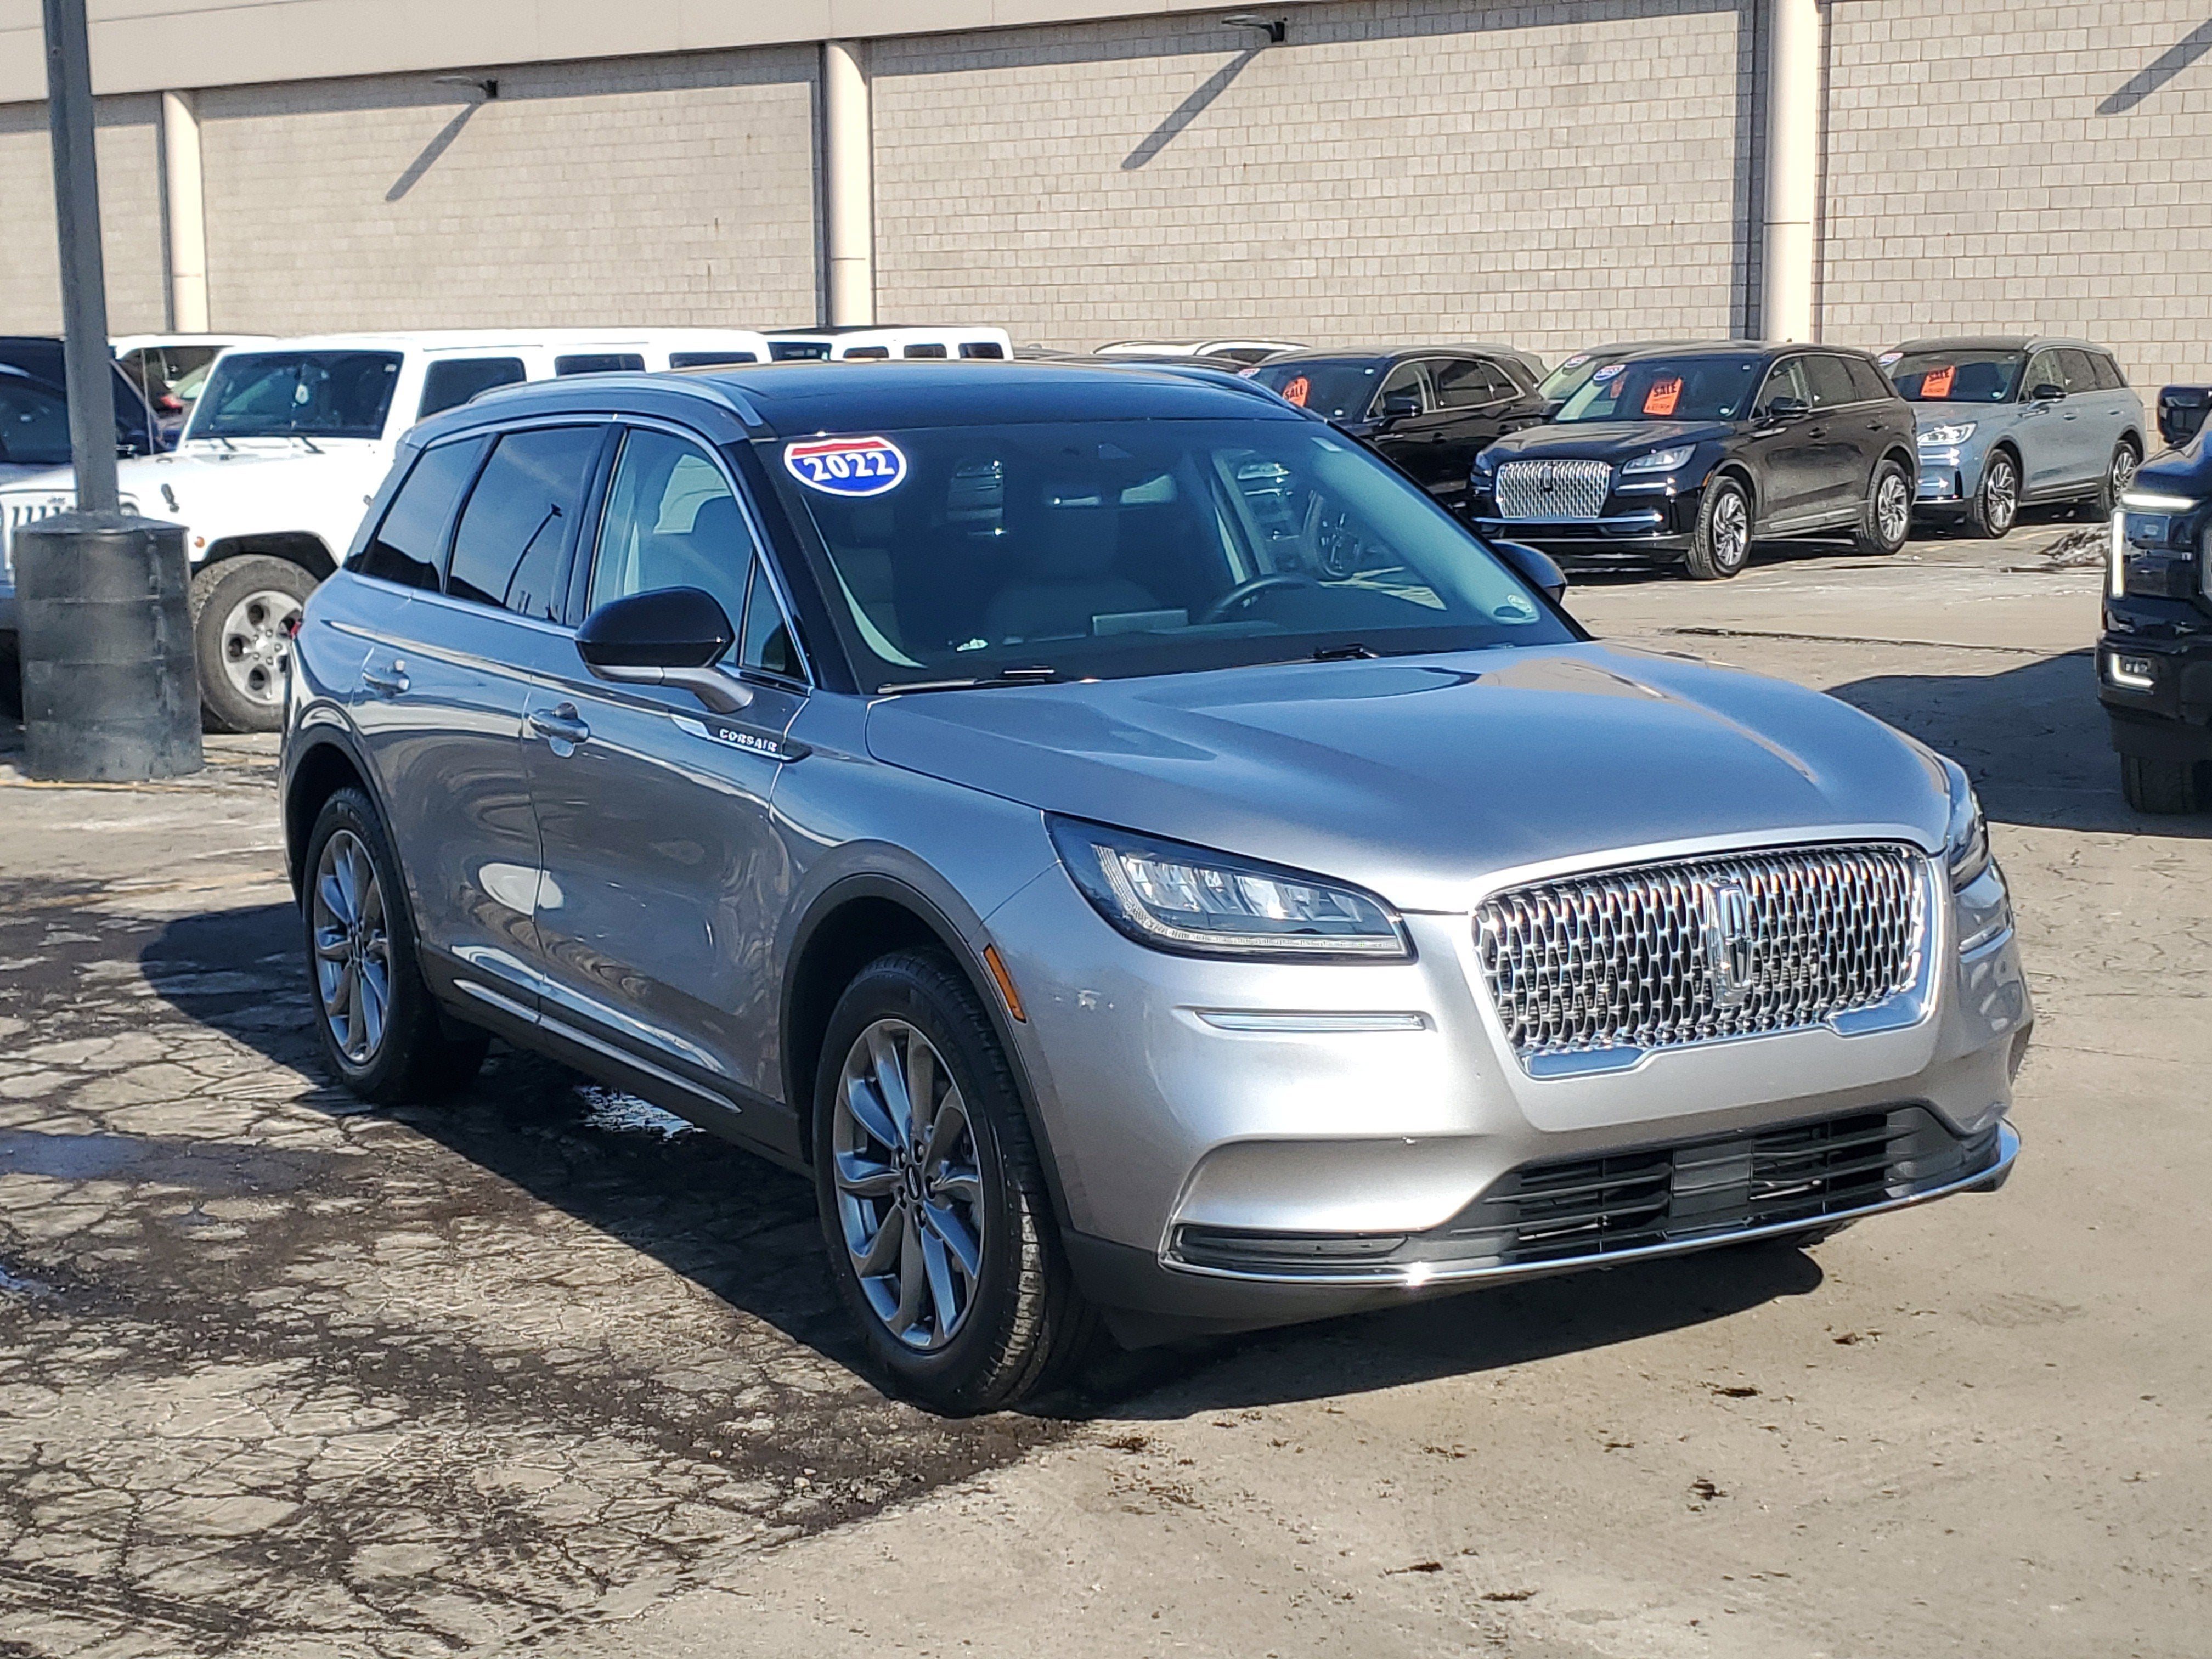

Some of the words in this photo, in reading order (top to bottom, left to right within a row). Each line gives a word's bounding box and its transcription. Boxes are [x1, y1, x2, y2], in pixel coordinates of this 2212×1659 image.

[1284, 385, 1304, 400] SALE
[1653, 383, 1677, 397] SALE
[804, 452, 895, 481] 2022
[719, 728, 778, 752] CORSAIR
